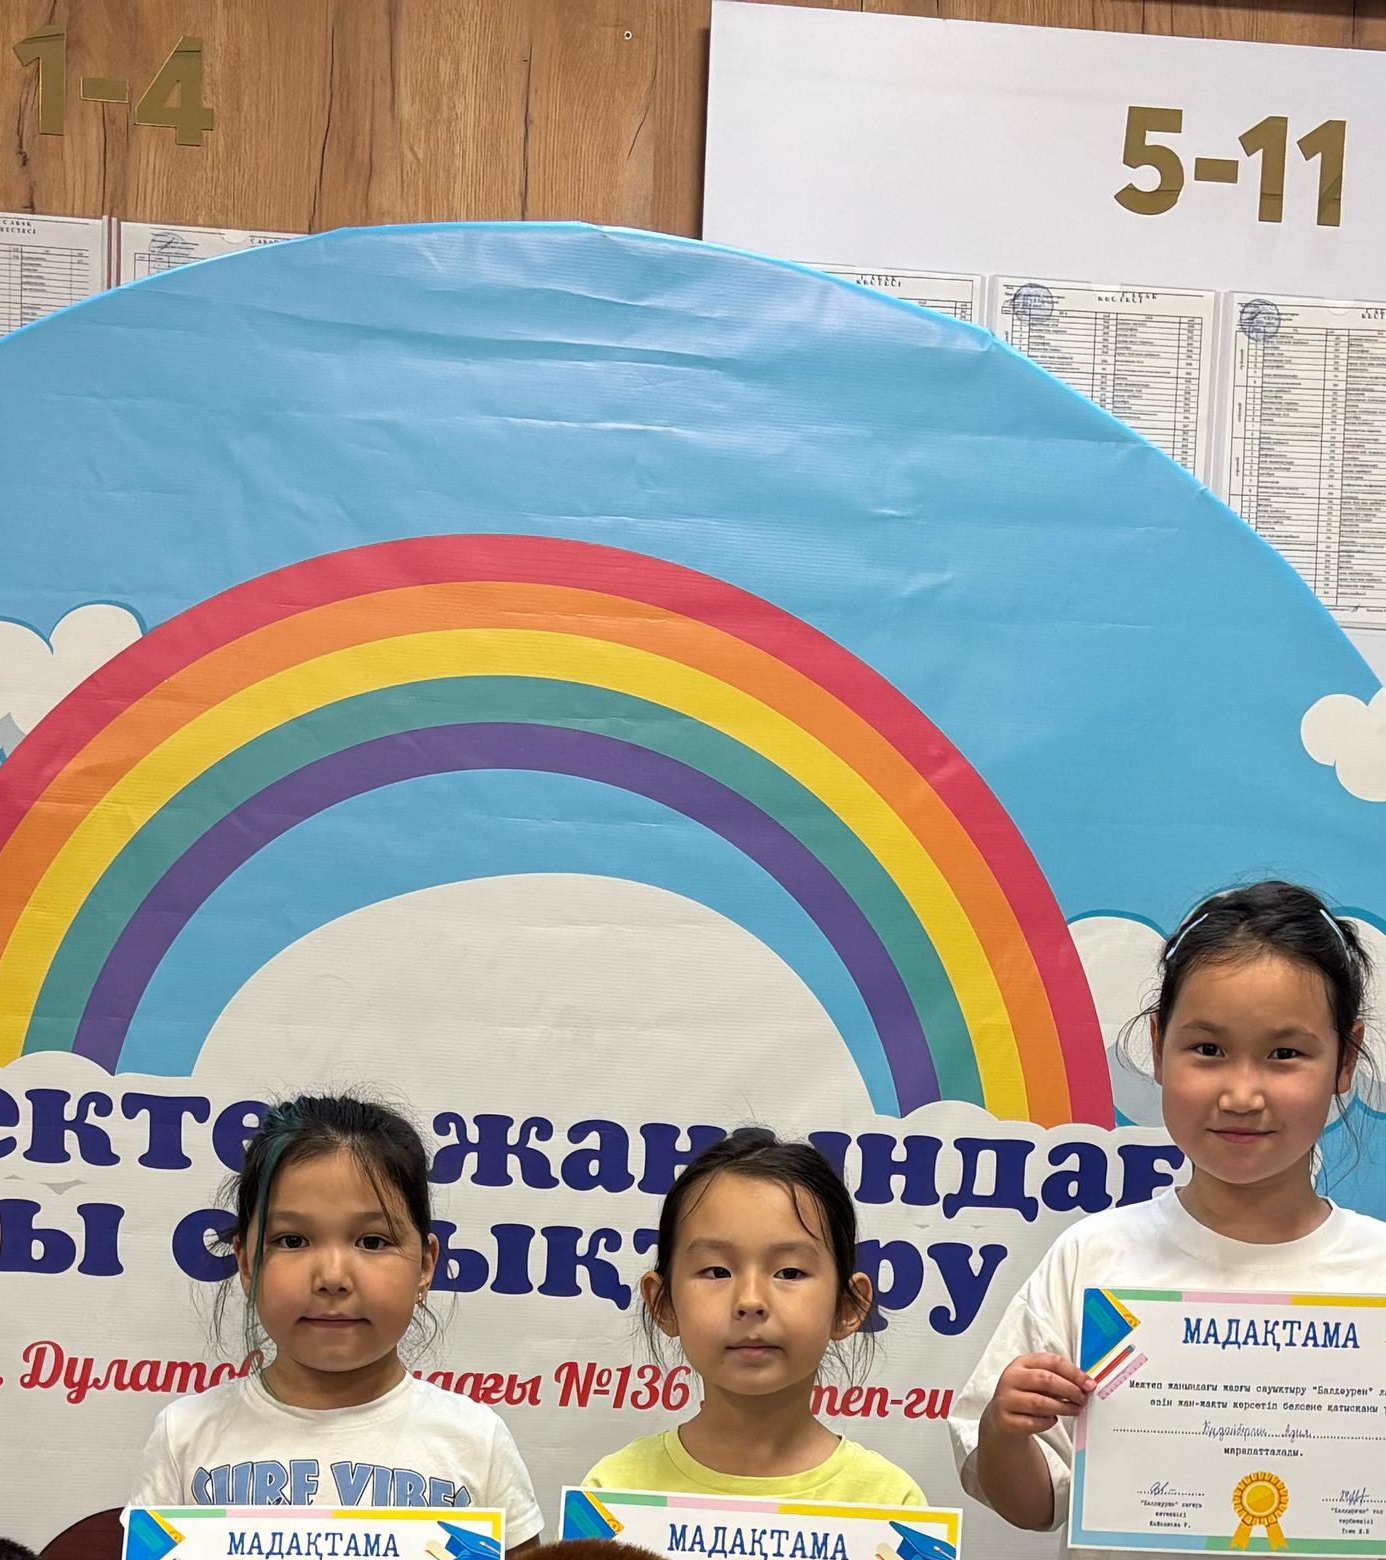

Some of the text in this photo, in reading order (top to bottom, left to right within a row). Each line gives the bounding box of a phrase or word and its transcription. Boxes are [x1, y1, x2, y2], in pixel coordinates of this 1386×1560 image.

[12, 24, 215, 147] 1-4
[1114, 105, 1348, 228] 5-11
[1182, 1317, 1361, 1353] МАДАҚТАМА
[554, 1361, 691, 1412] №136
[226, 1531, 400, 1560] МАДАҚТАМА
